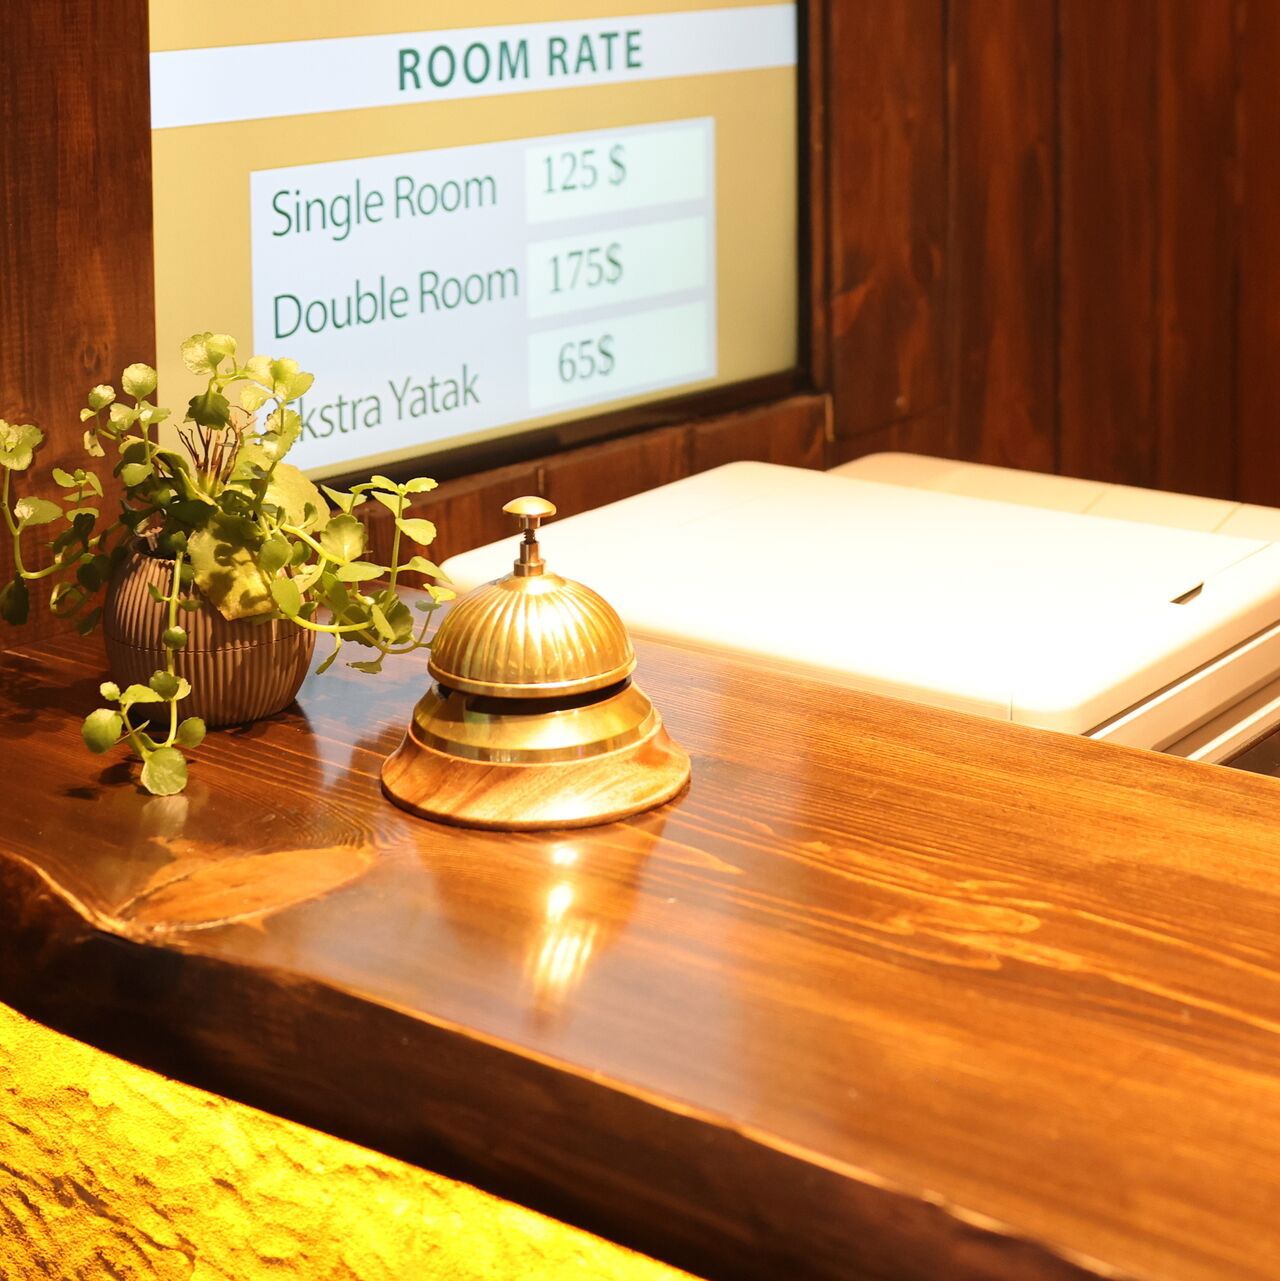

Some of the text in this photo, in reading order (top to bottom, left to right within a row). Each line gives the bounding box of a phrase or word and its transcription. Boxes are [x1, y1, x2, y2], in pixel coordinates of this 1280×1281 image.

[398, 29, 644, 91] ROOM RATE
[271, 143, 628, 242] Single Room 125 $
[273, 242, 623, 339] Double Room 175$
[282, 335, 616, 443] kstra Yatak 65$
